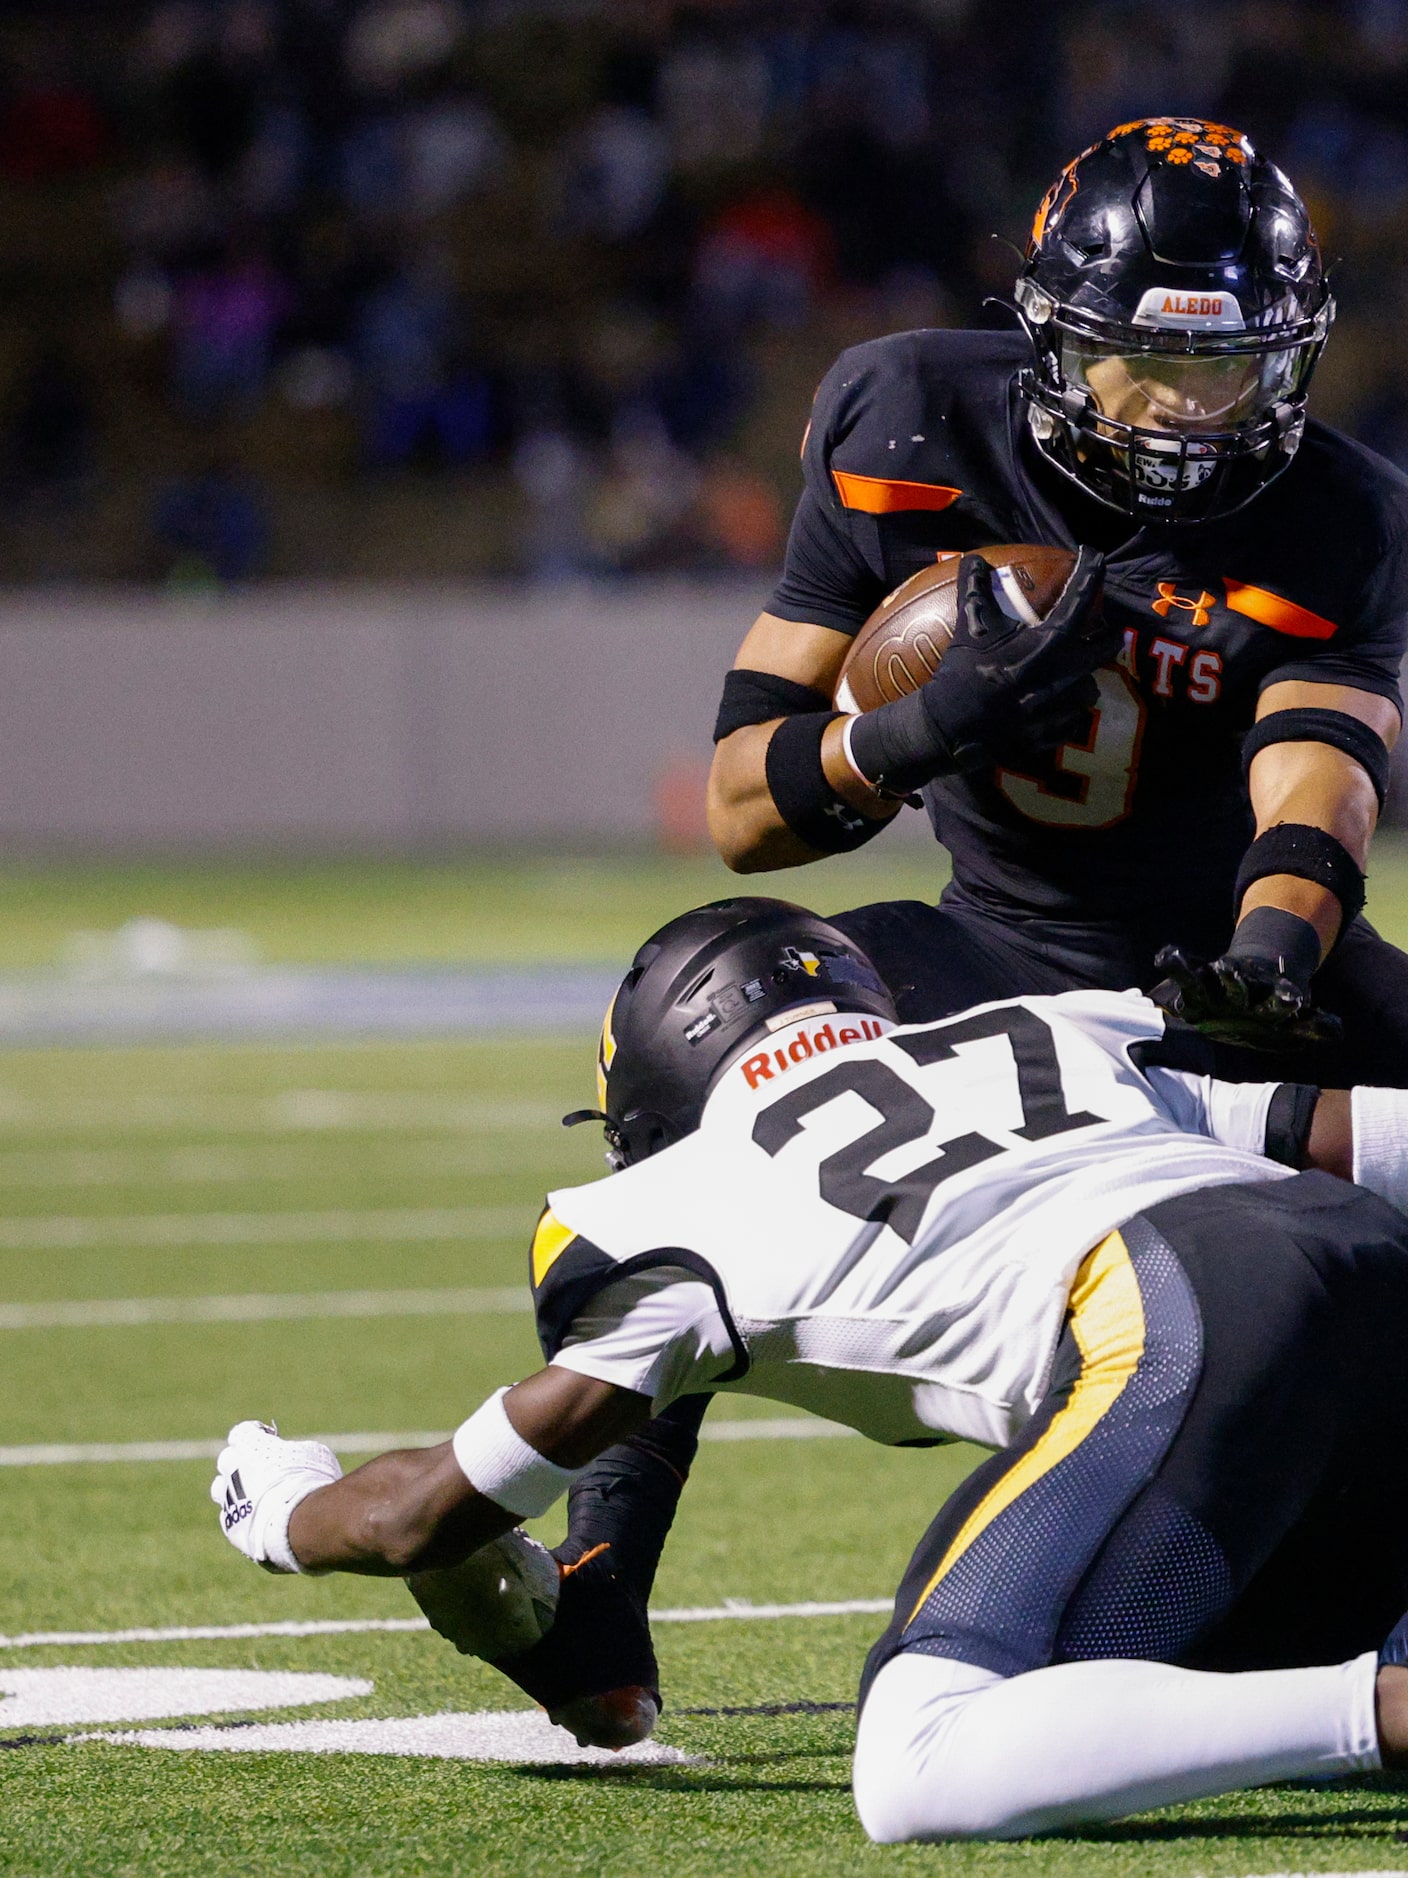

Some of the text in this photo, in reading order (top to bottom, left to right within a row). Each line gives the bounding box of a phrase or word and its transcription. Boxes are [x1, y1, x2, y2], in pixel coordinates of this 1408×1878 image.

[1161, 295, 1223, 316] ALEDO
[996, 662, 1148, 831] 3
[740, 1019, 884, 1091] Riddell
[751, 1004, 1110, 1246] 27
